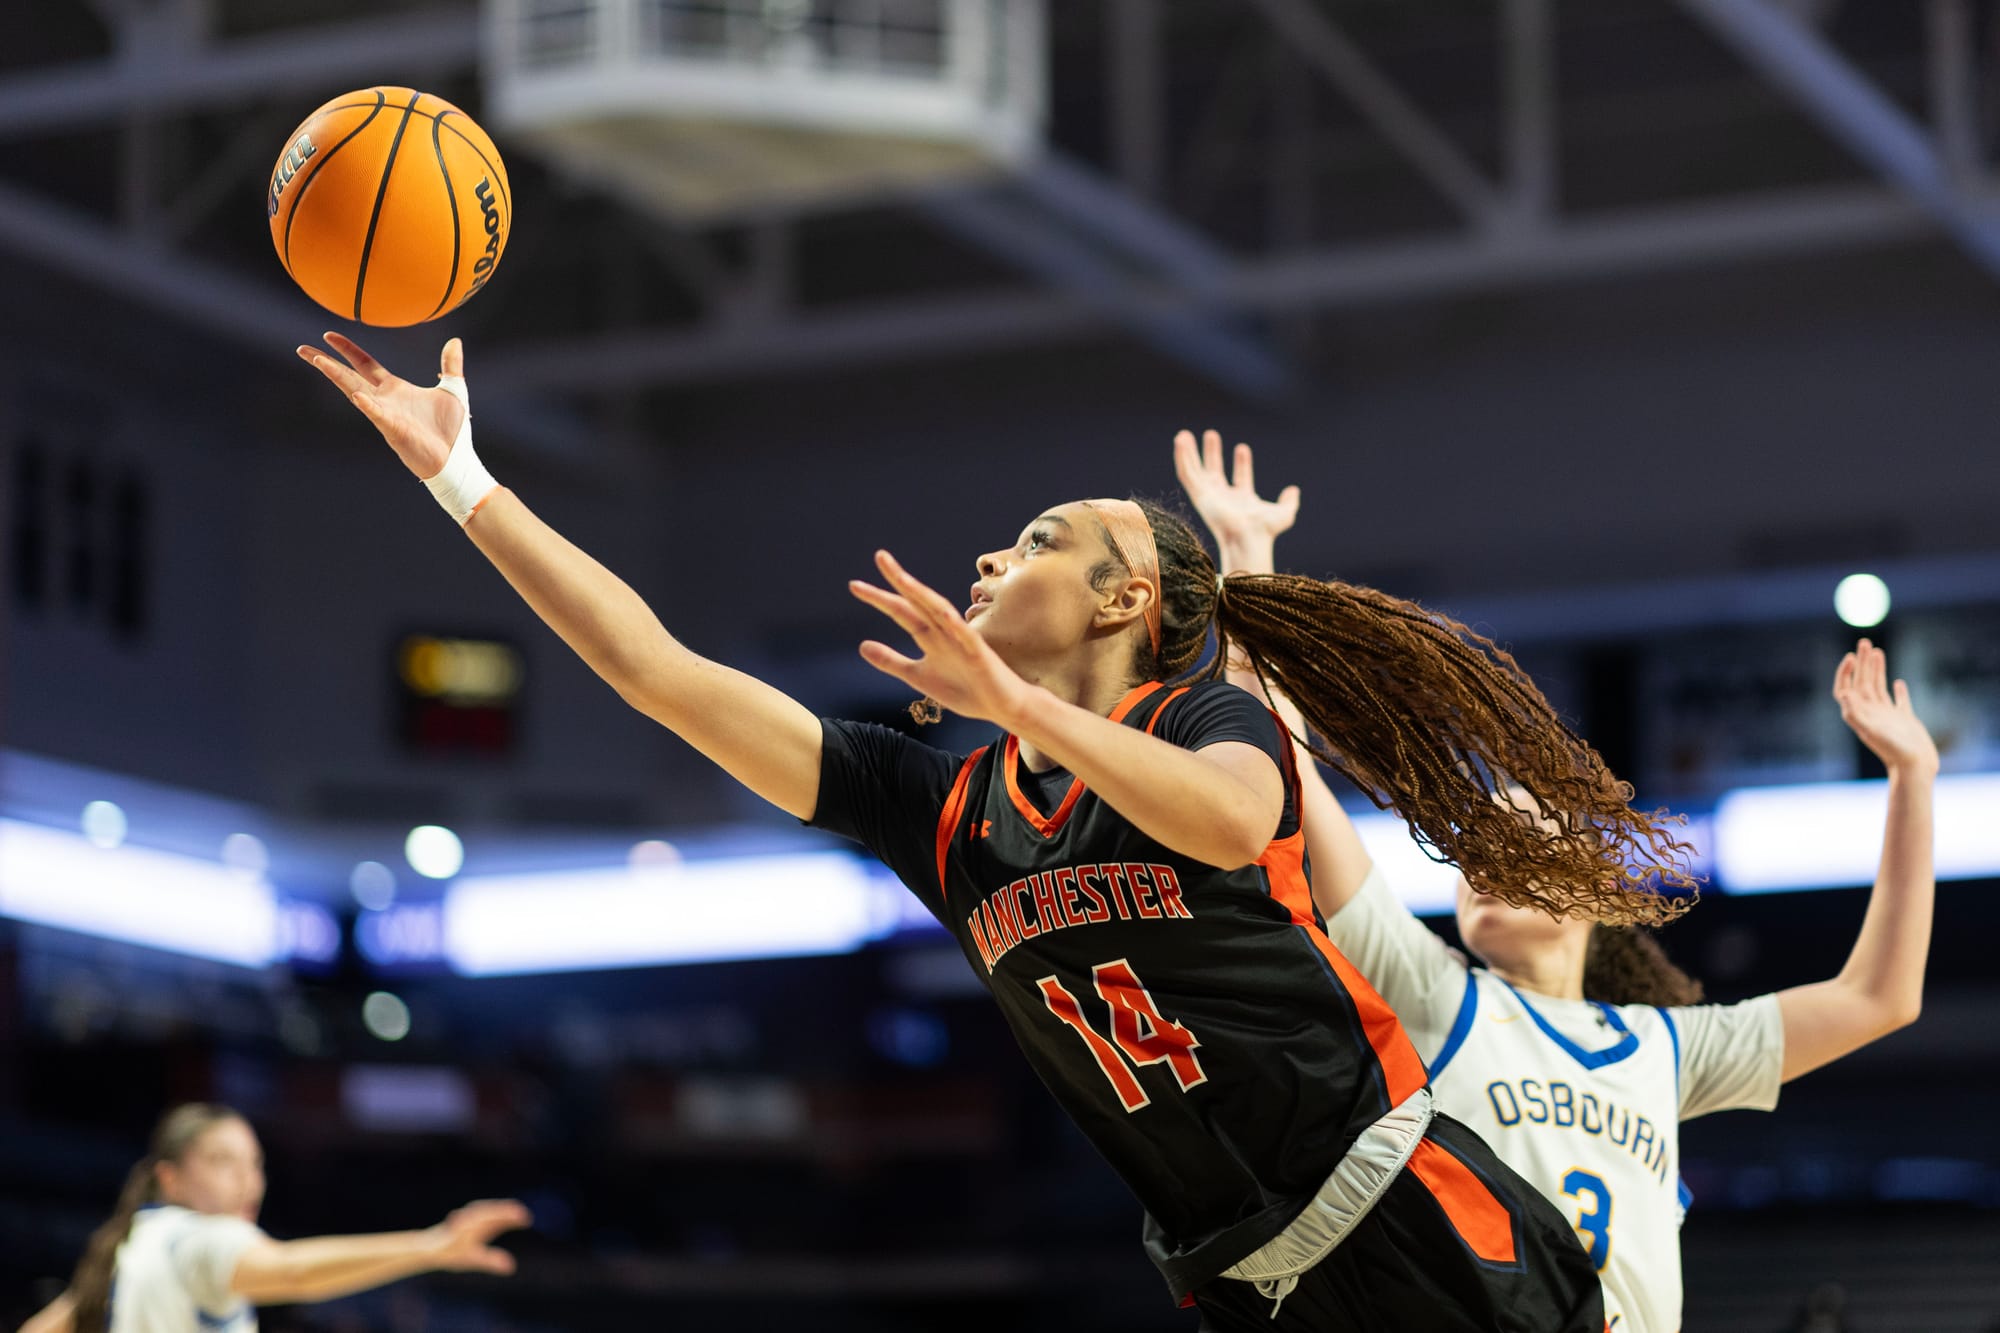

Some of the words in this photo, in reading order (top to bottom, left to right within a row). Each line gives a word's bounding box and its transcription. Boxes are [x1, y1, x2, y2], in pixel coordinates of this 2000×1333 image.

[967, 862, 1194, 976] MANCHESTER
[1035, 957, 1209, 1114] 14
[1486, 1078, 1669, 1186] OSBOURN
[1559, 1165, 1614, 1274] 3
